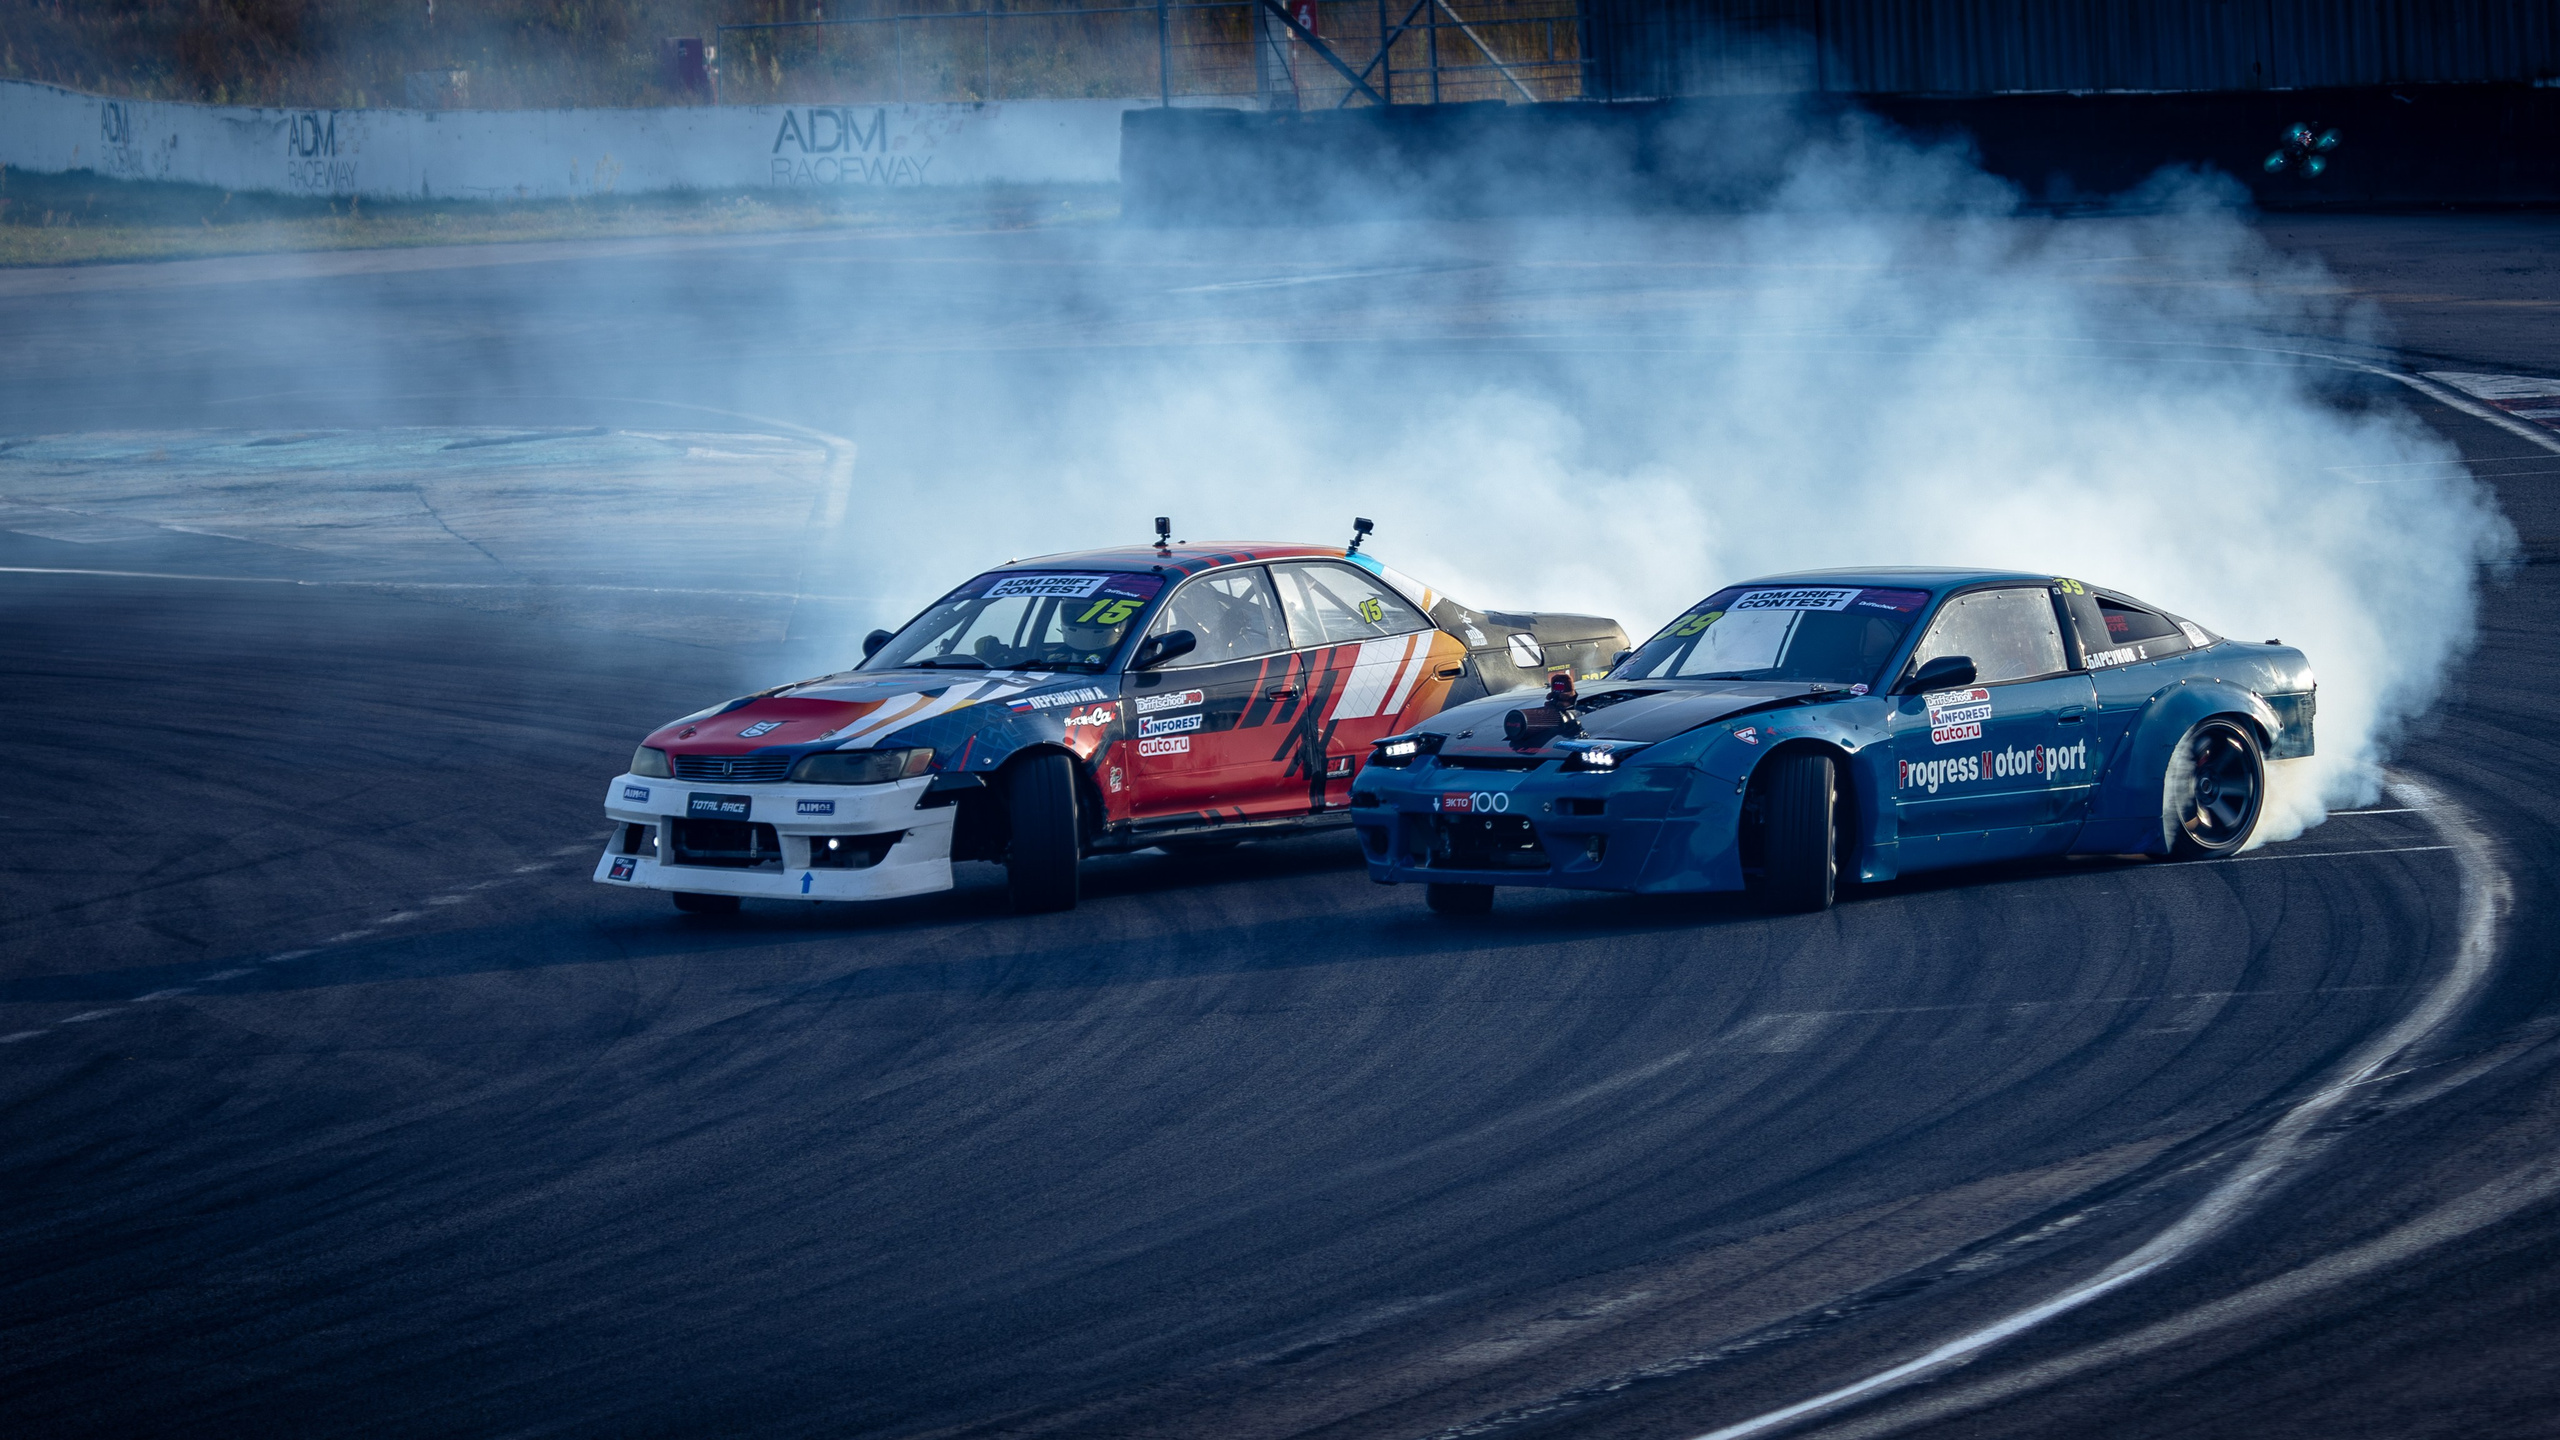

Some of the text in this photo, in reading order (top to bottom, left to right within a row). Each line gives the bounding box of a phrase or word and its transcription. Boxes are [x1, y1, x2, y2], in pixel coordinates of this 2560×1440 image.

[288, 112, 335, 157] ADM
[772, 108, 887, 153] ADM
[288, 160, 358, 188] RACEWAY
[771, 155, 933, 185] RACEWAY
[992, 586, 1090, 596] CONTEST
[1001, 577, 1099, 587] ADM DRIFT
[2055, 578, 2085, 595] 39
[1737, 598, 1843, 609] CONTEST
[1745, 590, 1852, 600] ADM DRIFT
[1076, 599, 1145, 624] 15
[1359, 597, 1383, 624] 15
[1653, 611, 1724, 641] 39
[2086, 648, 2136, 669] БАРСУКОВ
[1027, 687, 1093, 709] ПЕРЕЖОГИН
[1140, 716, 1201, 735] KINFOREST
[1930, 707, 1990, 726] KINFOREST
[1933, 725, 1980, 742] auto.ru
[1140, 739, 1188, 754] auto.ru
[1899, 755, 1979, 794] Progress
[692, 800, 745, 813] TOTAL RACE
[1445, 792, 1509, 813] ЭКТО 100
